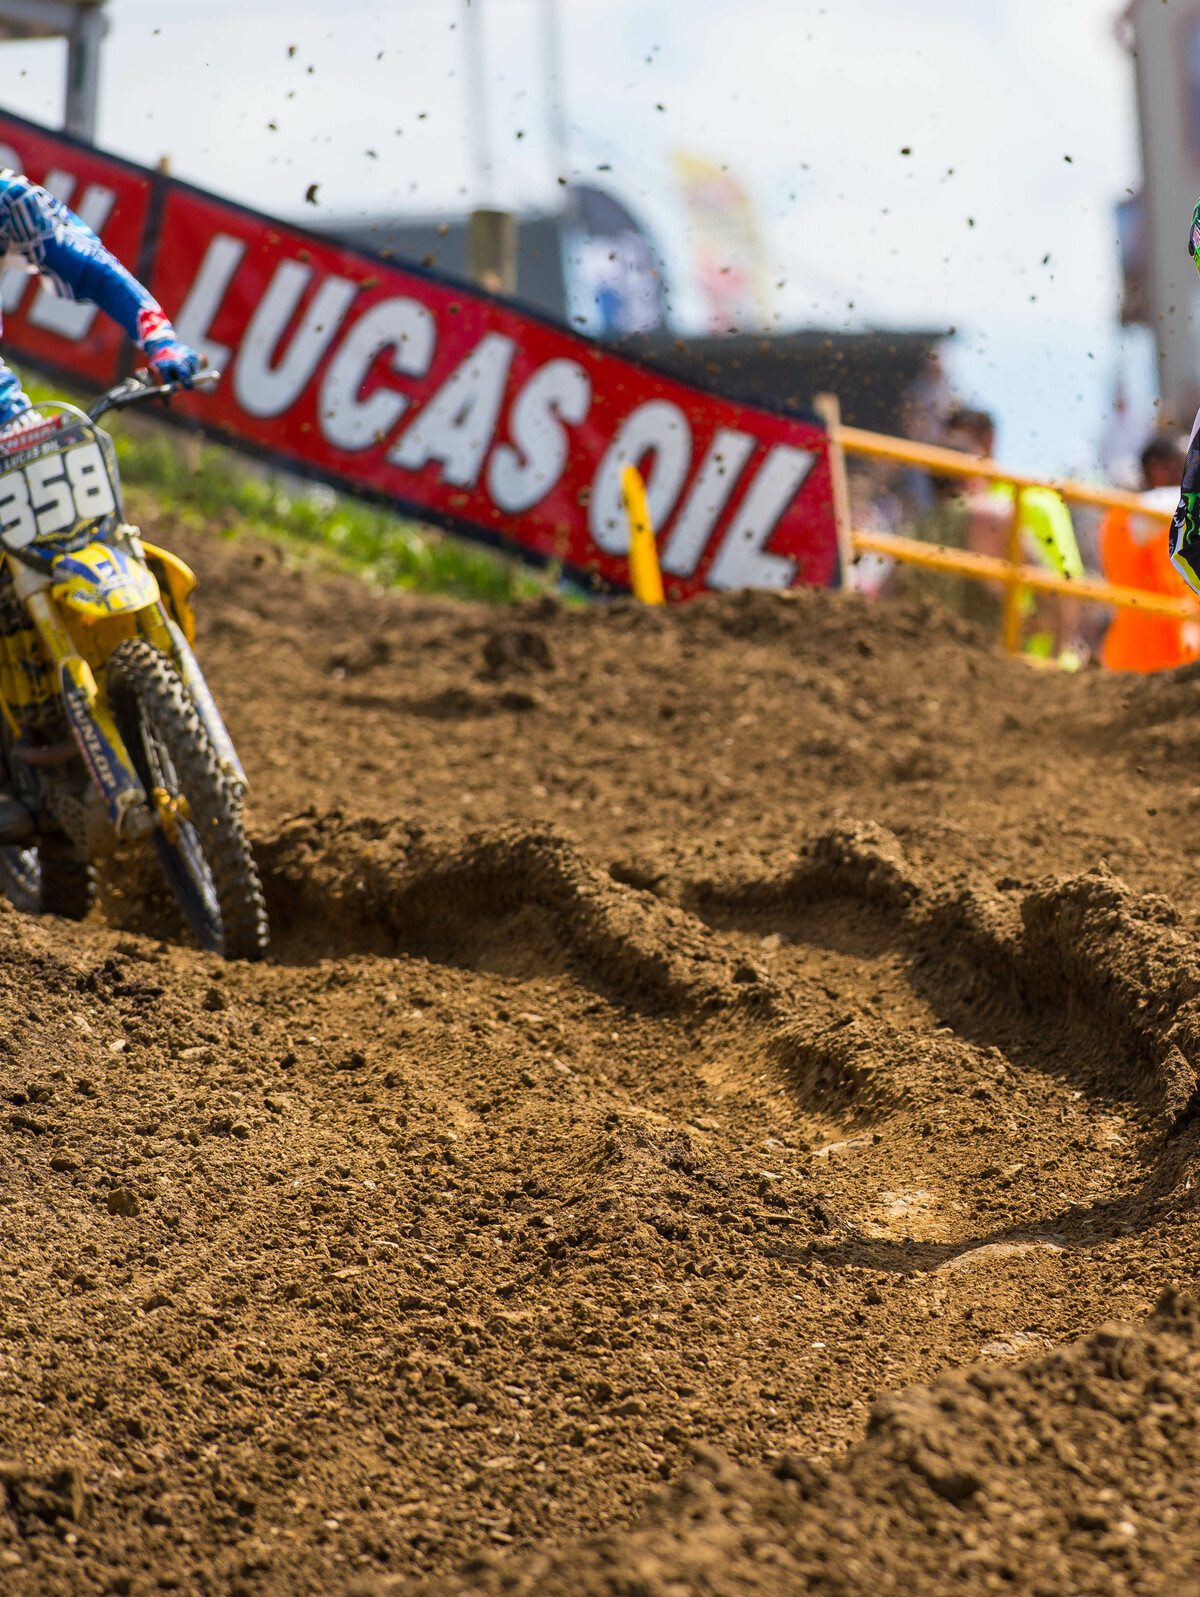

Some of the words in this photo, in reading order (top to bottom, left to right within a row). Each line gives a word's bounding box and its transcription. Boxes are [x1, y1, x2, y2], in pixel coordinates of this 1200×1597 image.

[0, 443, 117, 549] 358
[174, 232, 592, 514] LUCAS
[588, 400, 817, 592] OIL
